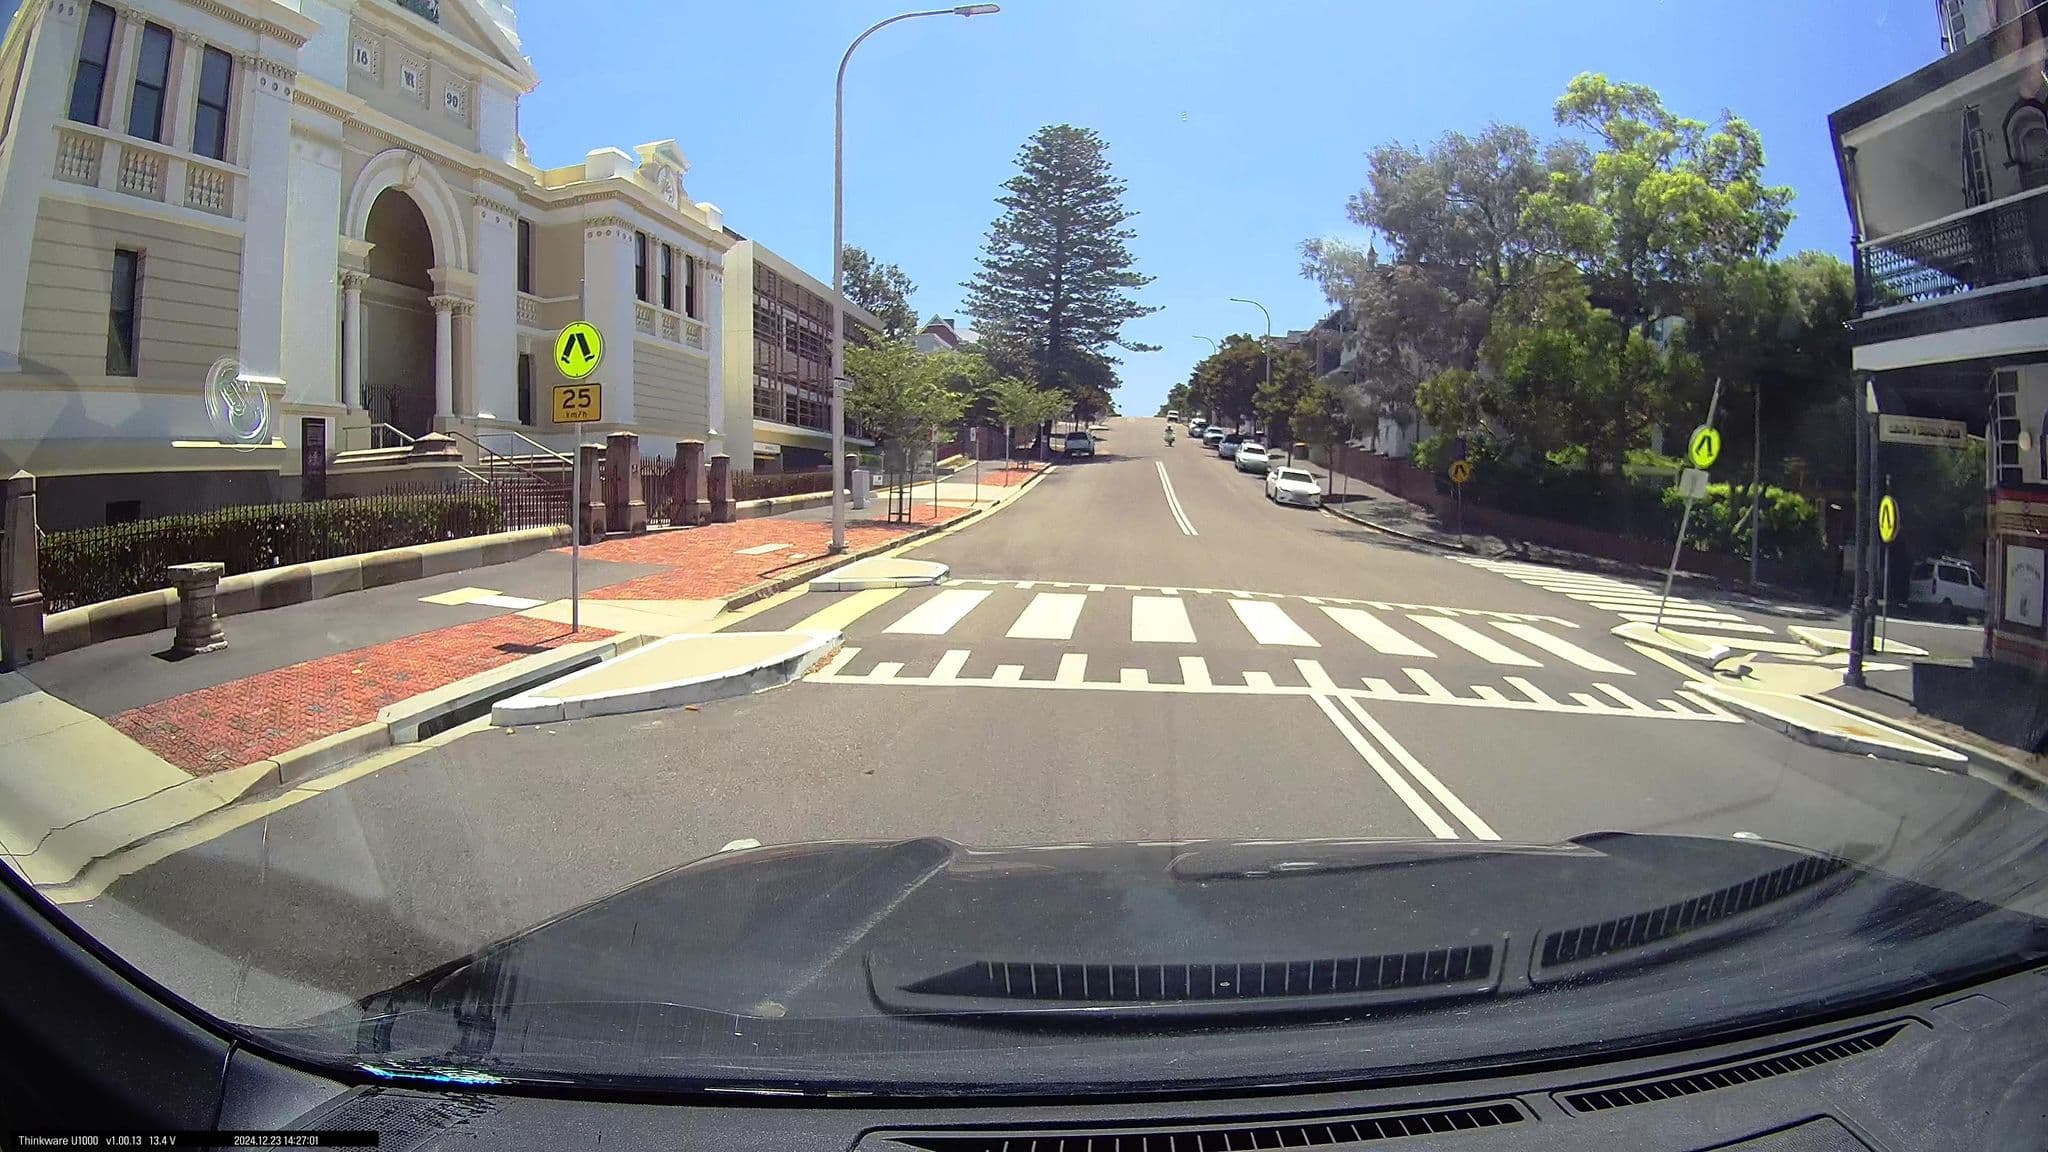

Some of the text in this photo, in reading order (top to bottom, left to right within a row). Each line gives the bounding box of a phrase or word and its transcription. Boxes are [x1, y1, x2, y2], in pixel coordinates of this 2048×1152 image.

[356, 48, 368, 65] 18
[446, 92, 459, 108] 90
[563, 388, 592, 409] 25
